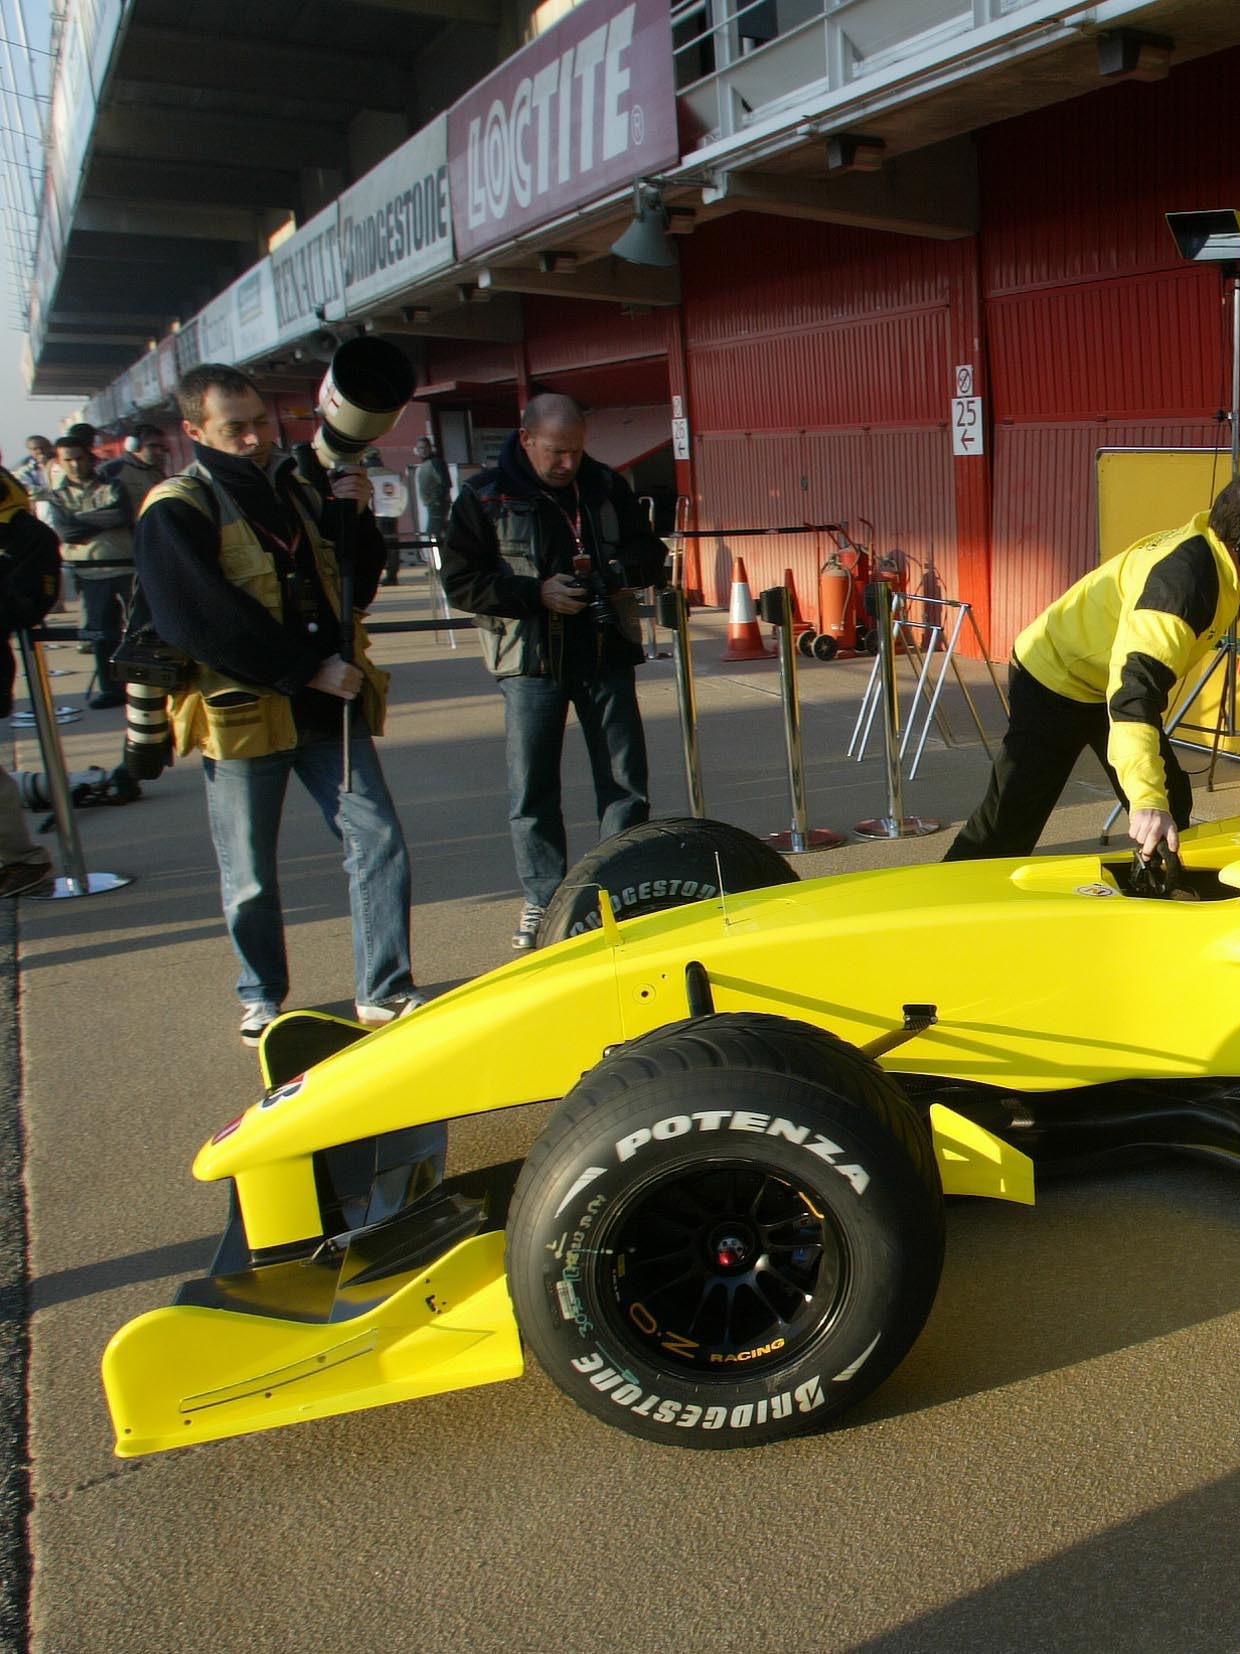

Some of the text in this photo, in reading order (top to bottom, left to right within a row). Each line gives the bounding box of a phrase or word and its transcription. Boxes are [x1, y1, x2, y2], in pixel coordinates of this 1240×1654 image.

[467, 3, 636, 229] LOCTITE
[343, 165, 448, 288] BRIDGESTONE
[956, 400, 976, 427] 25
[616, 1110, 871, 1195] POTENZA
[710, 1337, 785, 1363] RACING
[571, 1352, 825, 1430] BRIDGESTONE
